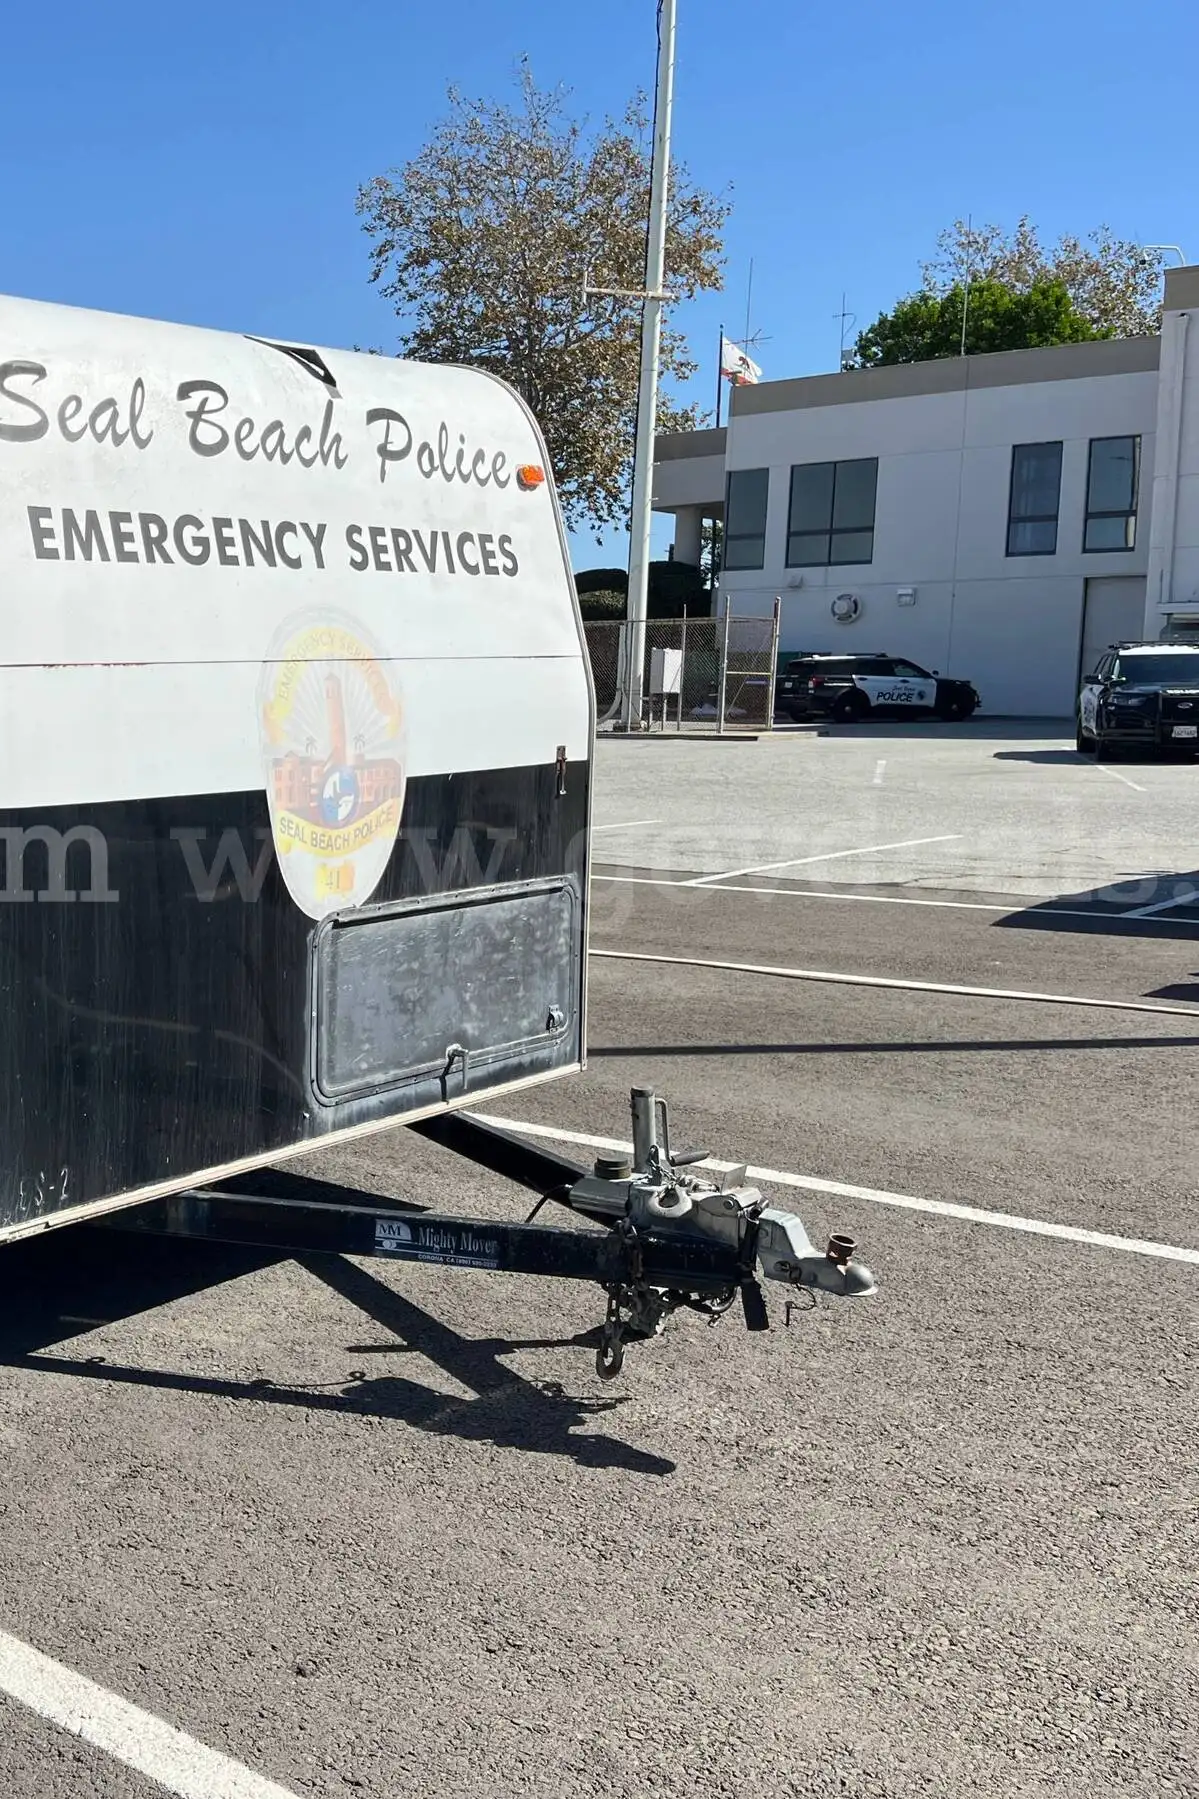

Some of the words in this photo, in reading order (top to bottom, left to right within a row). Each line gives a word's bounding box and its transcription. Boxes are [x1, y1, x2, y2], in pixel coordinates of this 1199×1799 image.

[177, 380, 349, 468] Beach
[366, 407, 511, 490] Police
[27, 505, 327, 569] EMERGENCY
[345, 524, 519, 578] SERVICES
[877, 691, 914, 702] POLICE
[279, 817, 307, 844] SEAL
[311, 828, 350, 853] BEACH
[353, 805, 394, 844] POLICE
[418, 1227, 457, 1254] Mighty
[460, 1232, 499, 1254] Mover
